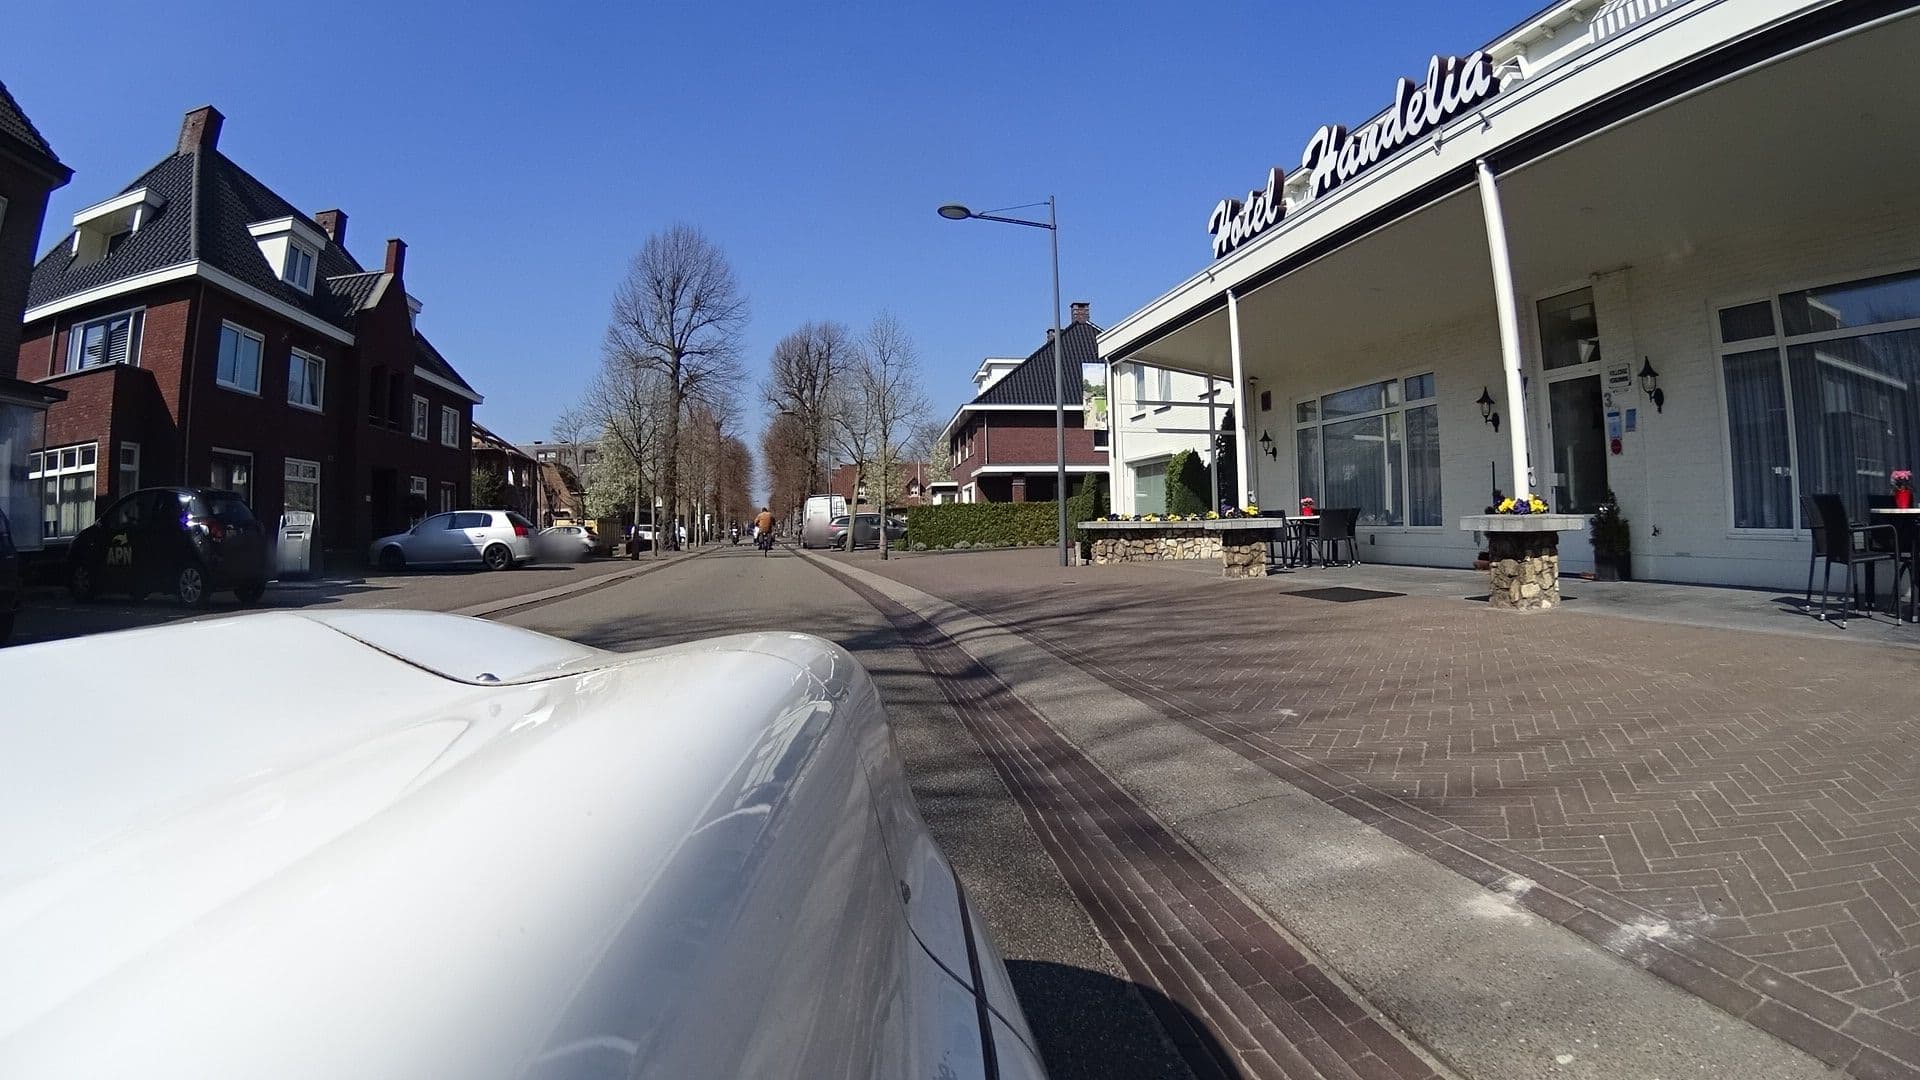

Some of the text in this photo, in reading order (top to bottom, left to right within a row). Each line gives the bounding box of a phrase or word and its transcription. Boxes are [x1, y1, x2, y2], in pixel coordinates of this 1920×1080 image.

[1208, 50, 1494, 259] Hotel Handelia
[106, 546, 133, 566] APN
